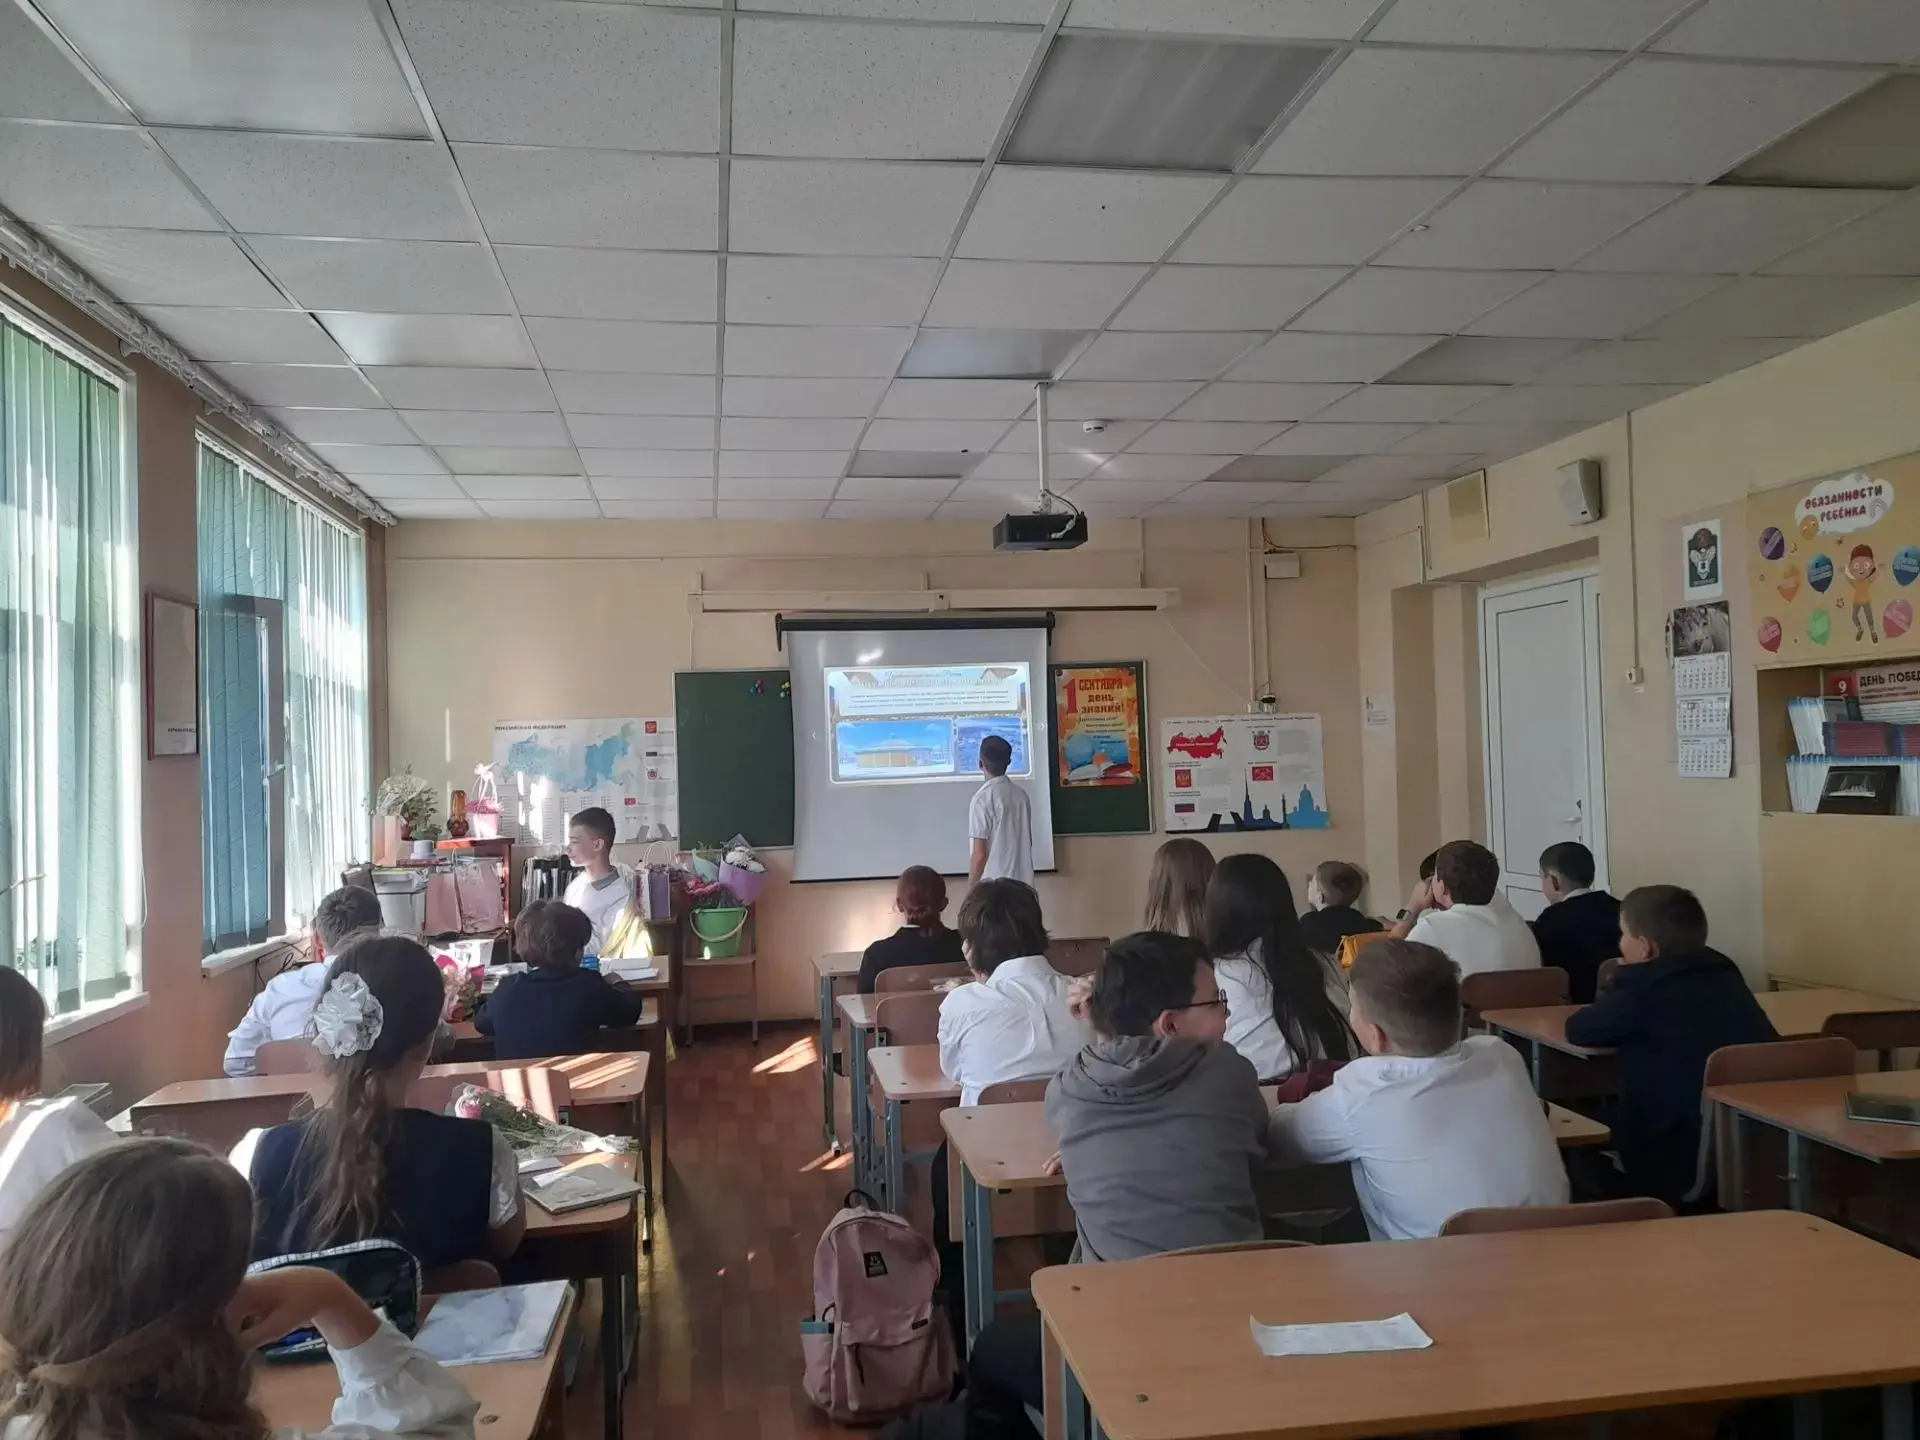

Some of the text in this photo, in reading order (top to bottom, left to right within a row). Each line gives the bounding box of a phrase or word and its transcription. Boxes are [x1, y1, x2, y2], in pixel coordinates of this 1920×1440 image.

[1805, 485, 1883, 509] ОБЯЗАННОСТИ
[1838, 680, 1847, 693] 9
[1860, 674, 1886, 687] ДЕНЬ
[1062, 678, 1123, 714] 1 СЕНТЯБРЯ
